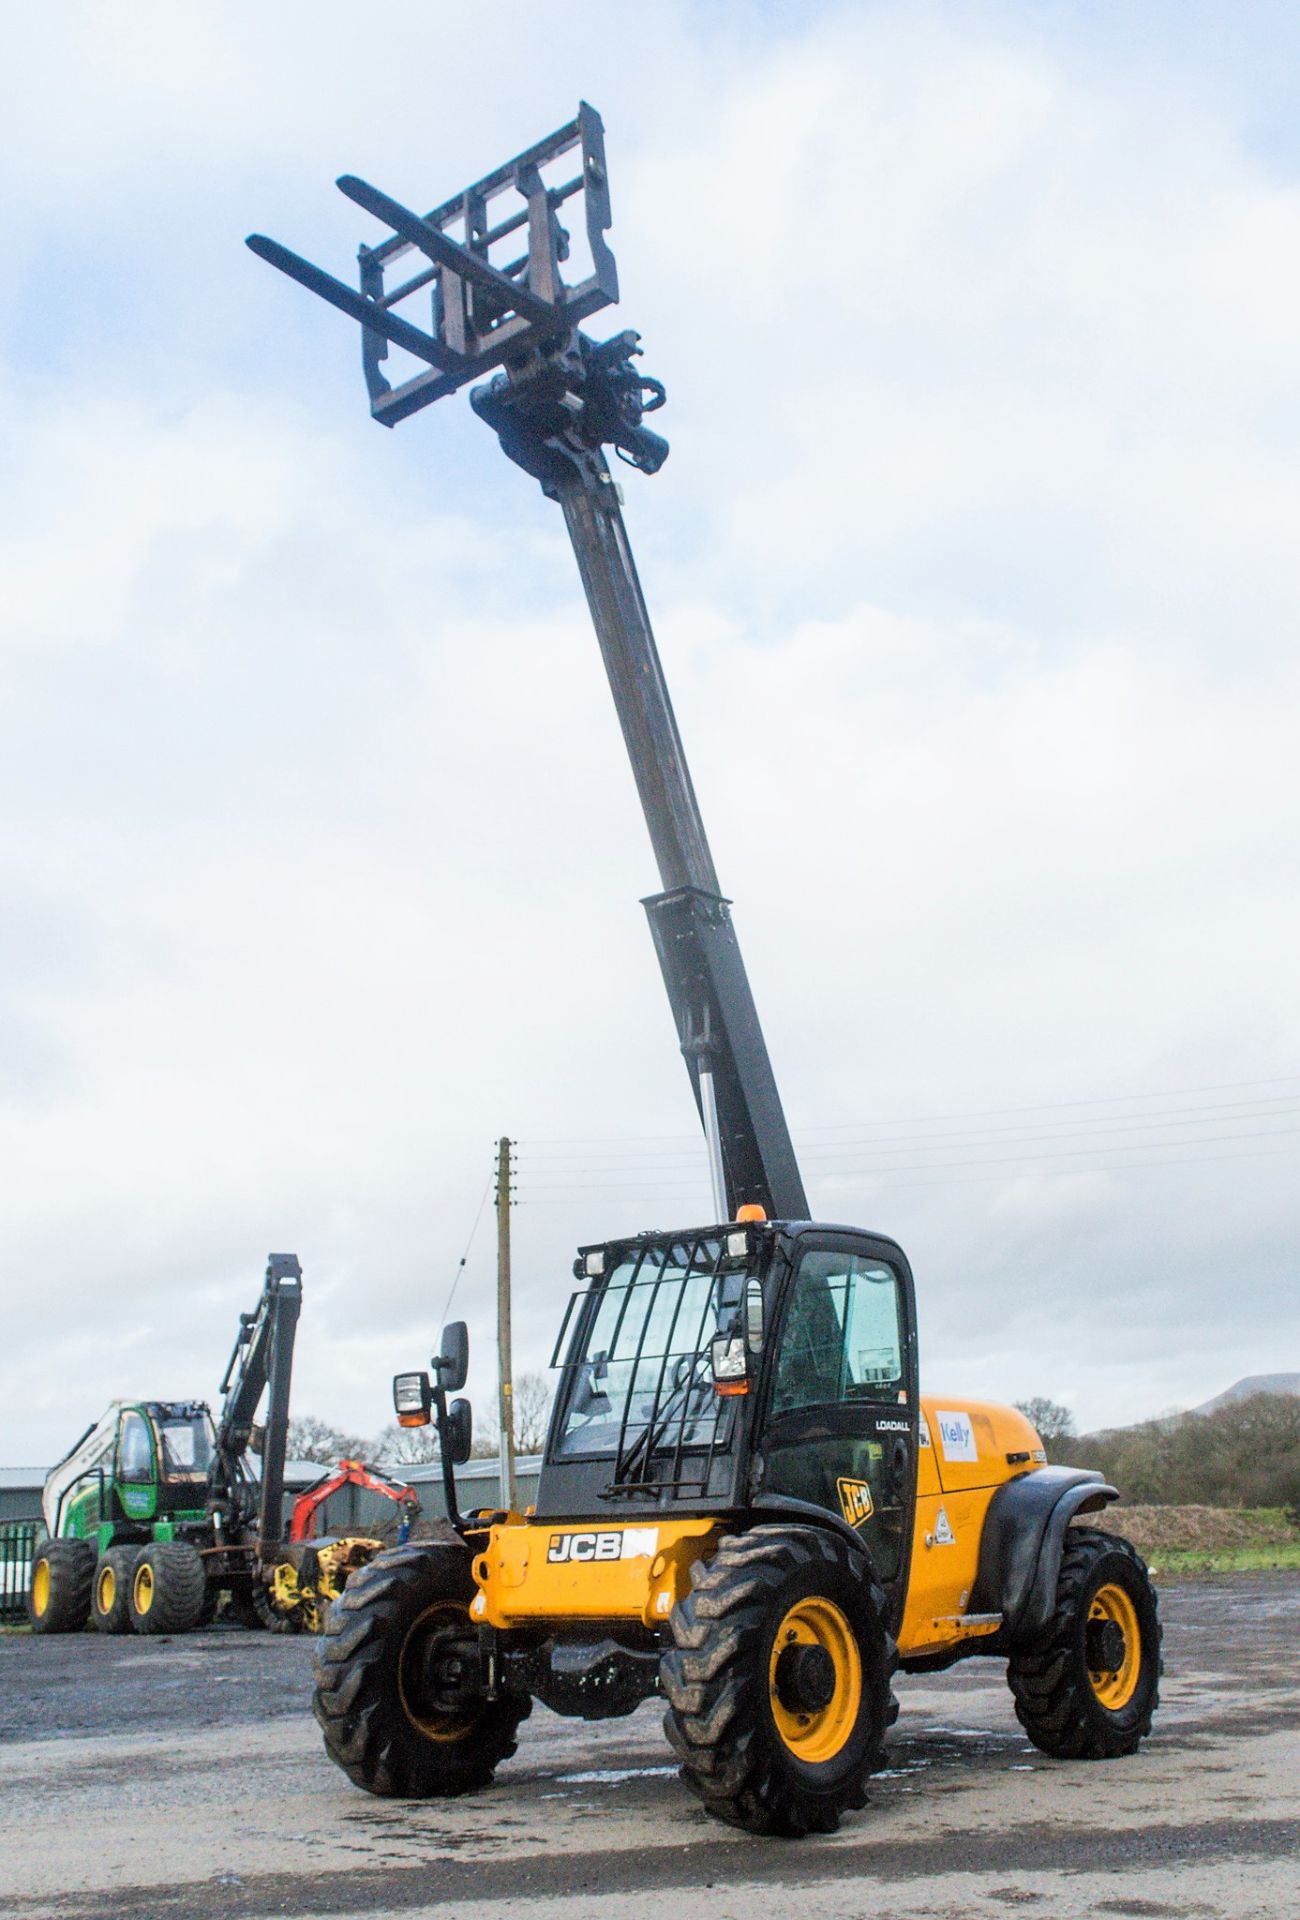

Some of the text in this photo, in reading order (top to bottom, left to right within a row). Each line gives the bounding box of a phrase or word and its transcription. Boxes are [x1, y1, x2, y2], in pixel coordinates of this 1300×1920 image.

[875, 1420, 910, 1432] LOADALL
[940, 1422, 970, 1447] Kelly
[842, 1483, 871, 1524] JCB
[548, 1532, 622, 1562] JCB
